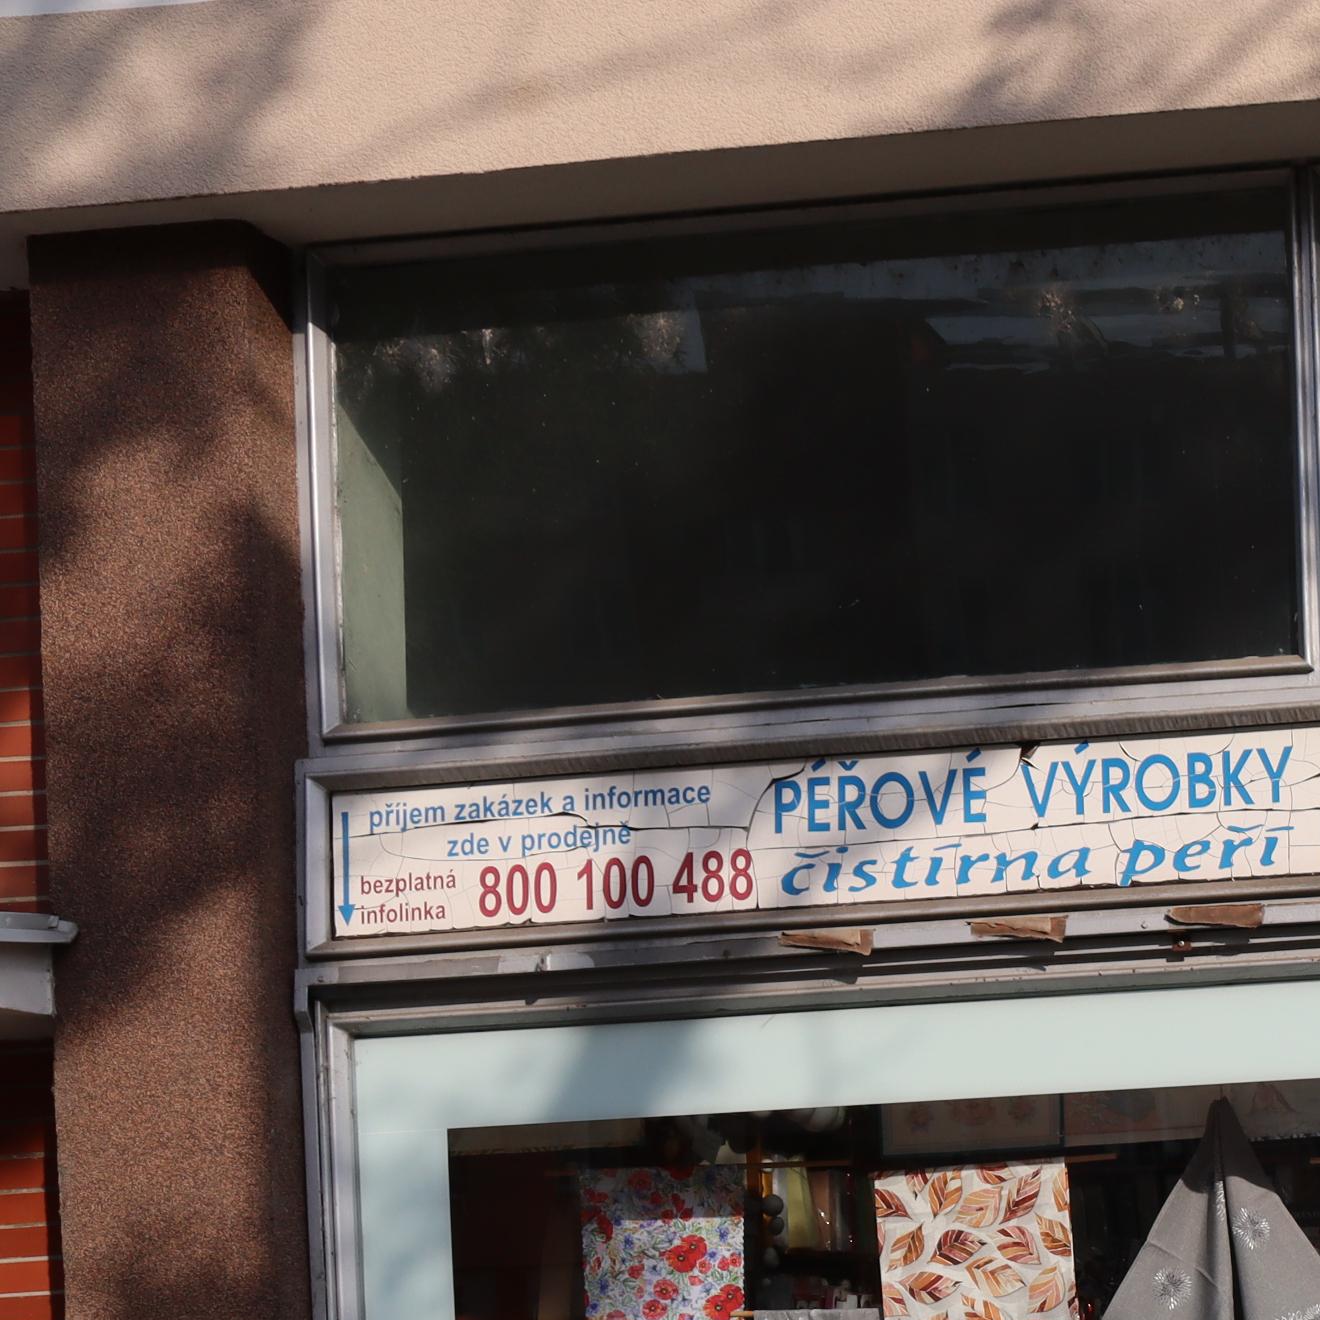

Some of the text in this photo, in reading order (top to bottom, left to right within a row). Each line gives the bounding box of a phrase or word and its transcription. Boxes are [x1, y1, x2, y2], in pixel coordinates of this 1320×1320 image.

[369, 784, 712, 836] příjem zakázek a informace
[775, 740, 1293, 833] PÉŘOVÉ VÝROBKY
[447, 821, 632, 857] zde v prodejně
[782, 825, 1295, 896] čistírna peří
[360, 869, 456, 897] bezplatná
[478, 848, 754, 918] 800 100 488
[360, 901, 446, 924] infolinka
